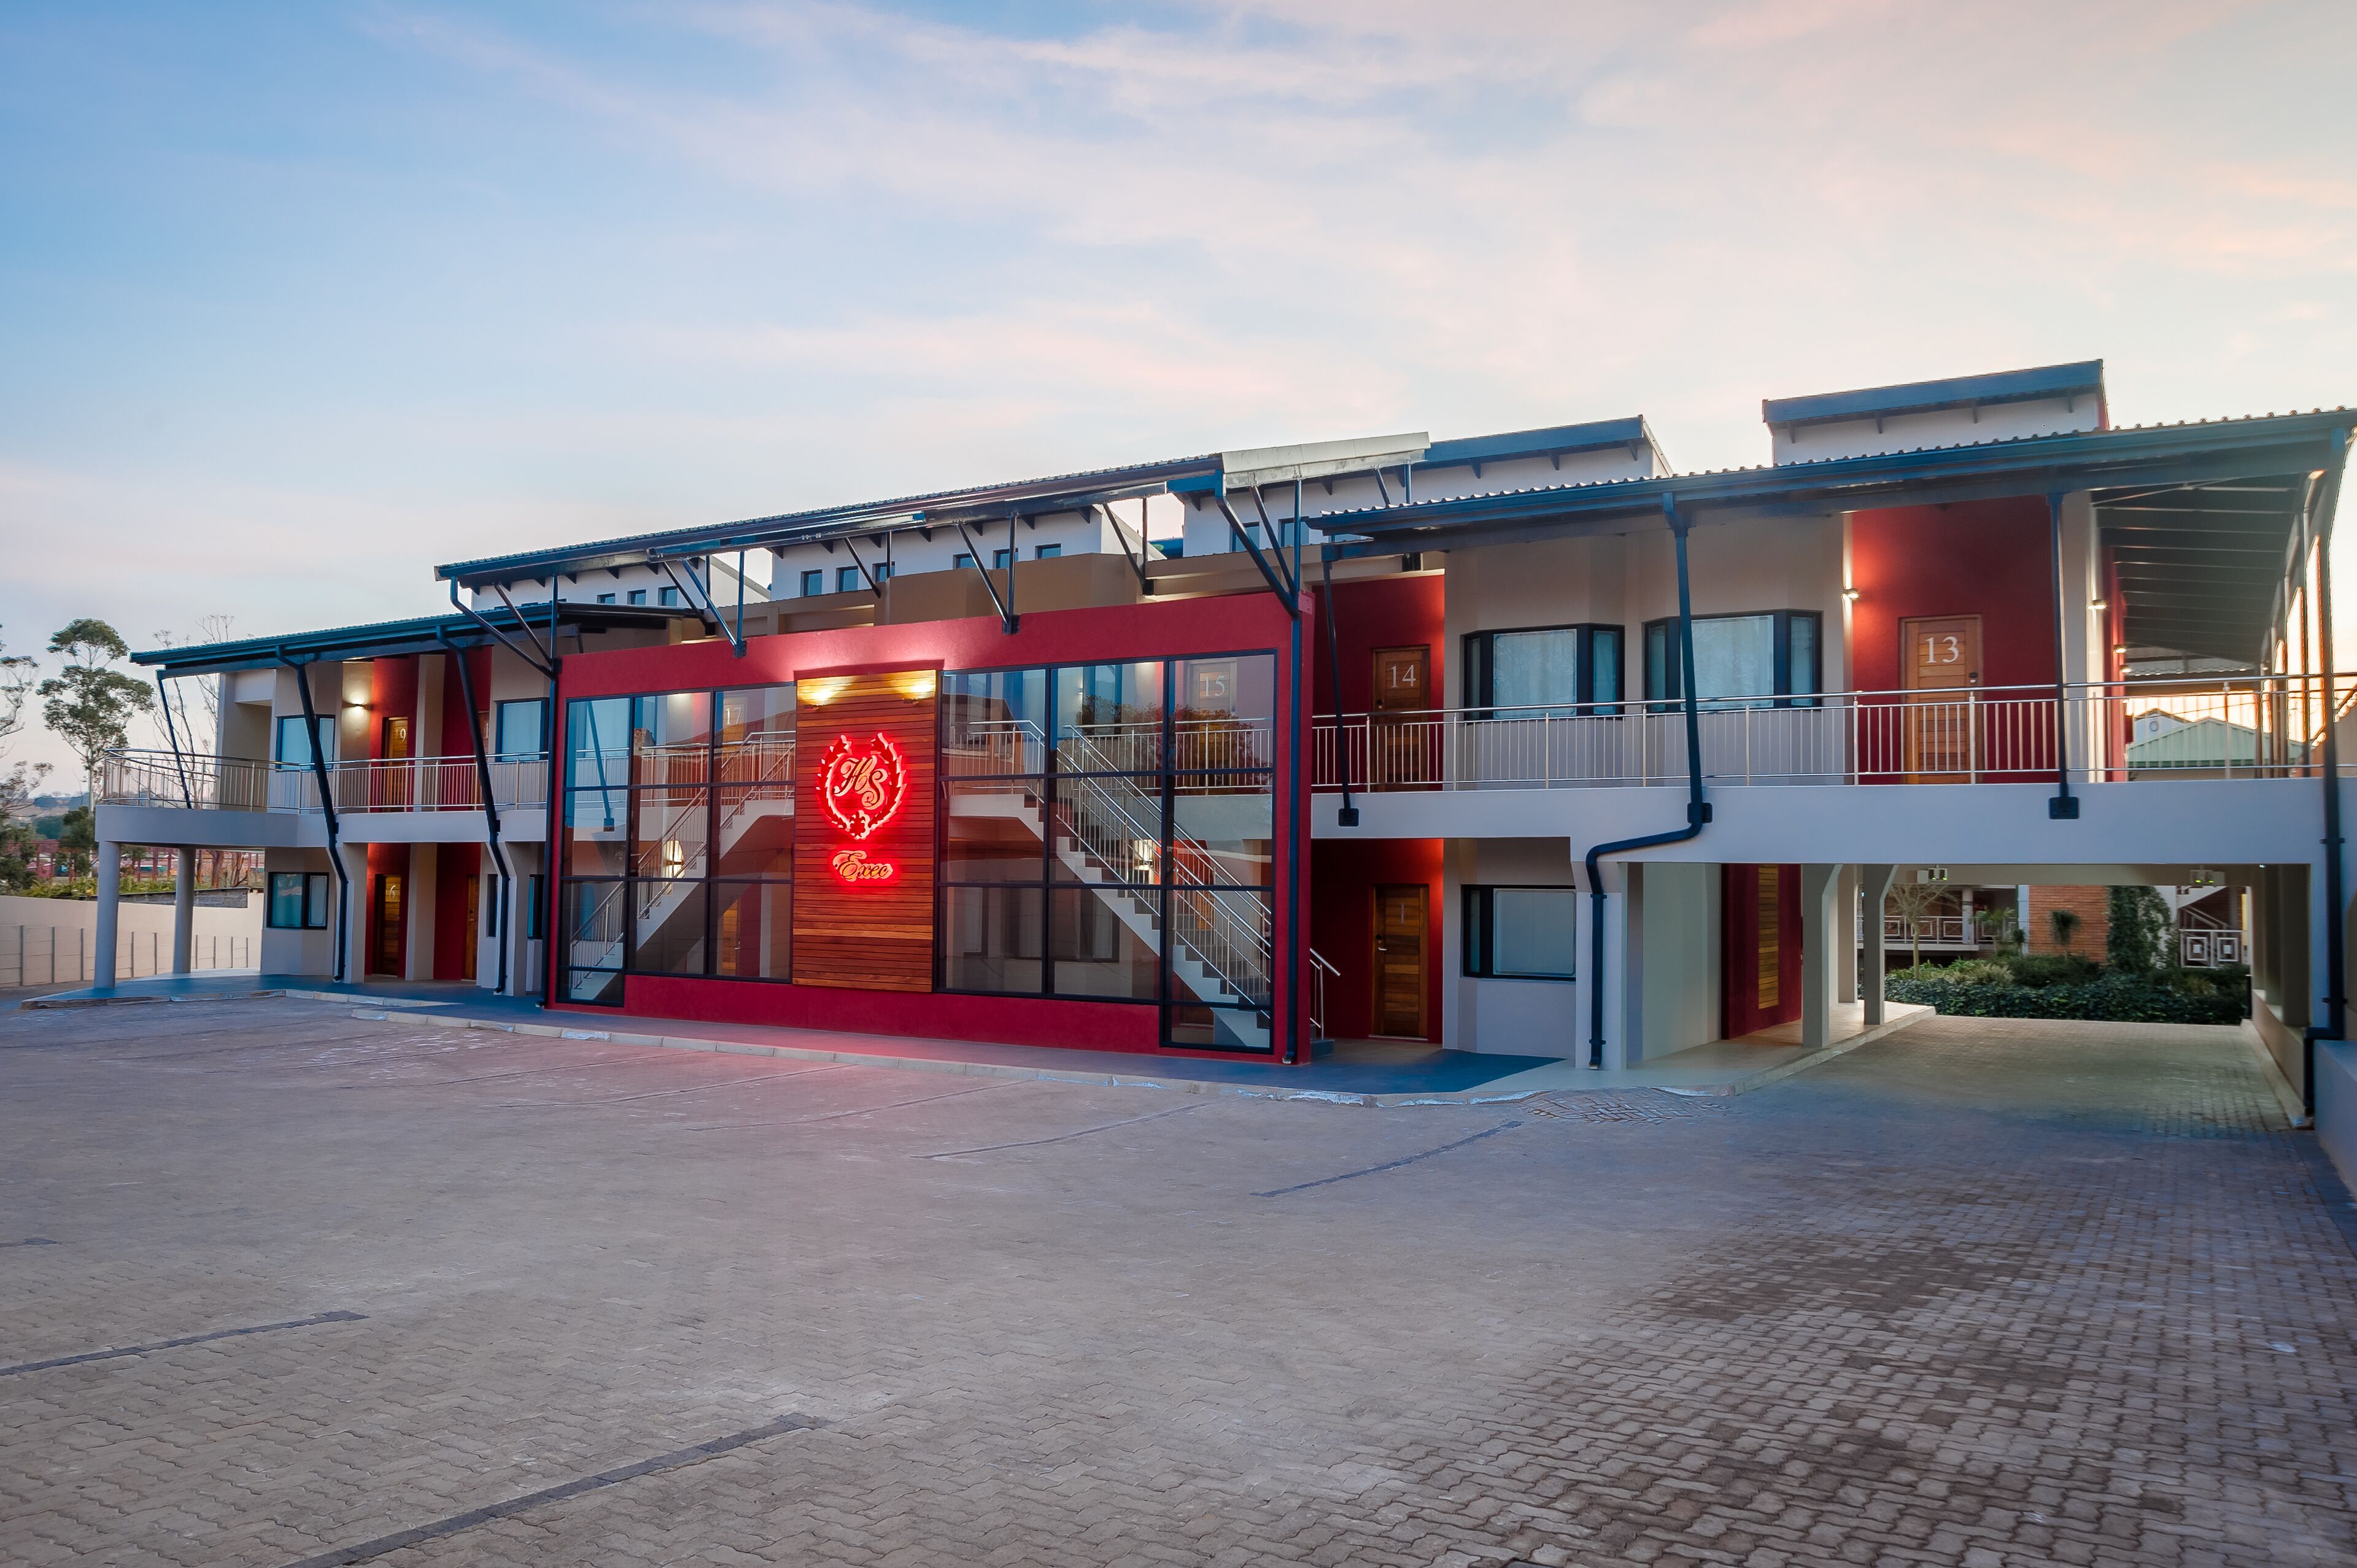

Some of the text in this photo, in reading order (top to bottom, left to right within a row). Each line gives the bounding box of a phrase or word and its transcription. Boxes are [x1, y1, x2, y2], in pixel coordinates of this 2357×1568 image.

[1925, 636, 1960, 663] 13
[1204, 674, 1226, 697] 15
[1390, 664, 1417, 688] 14
[725, 706, 742, 725] 17
[834, 851, 891, 880] Exec
[389, 884, 397, 900] 6
